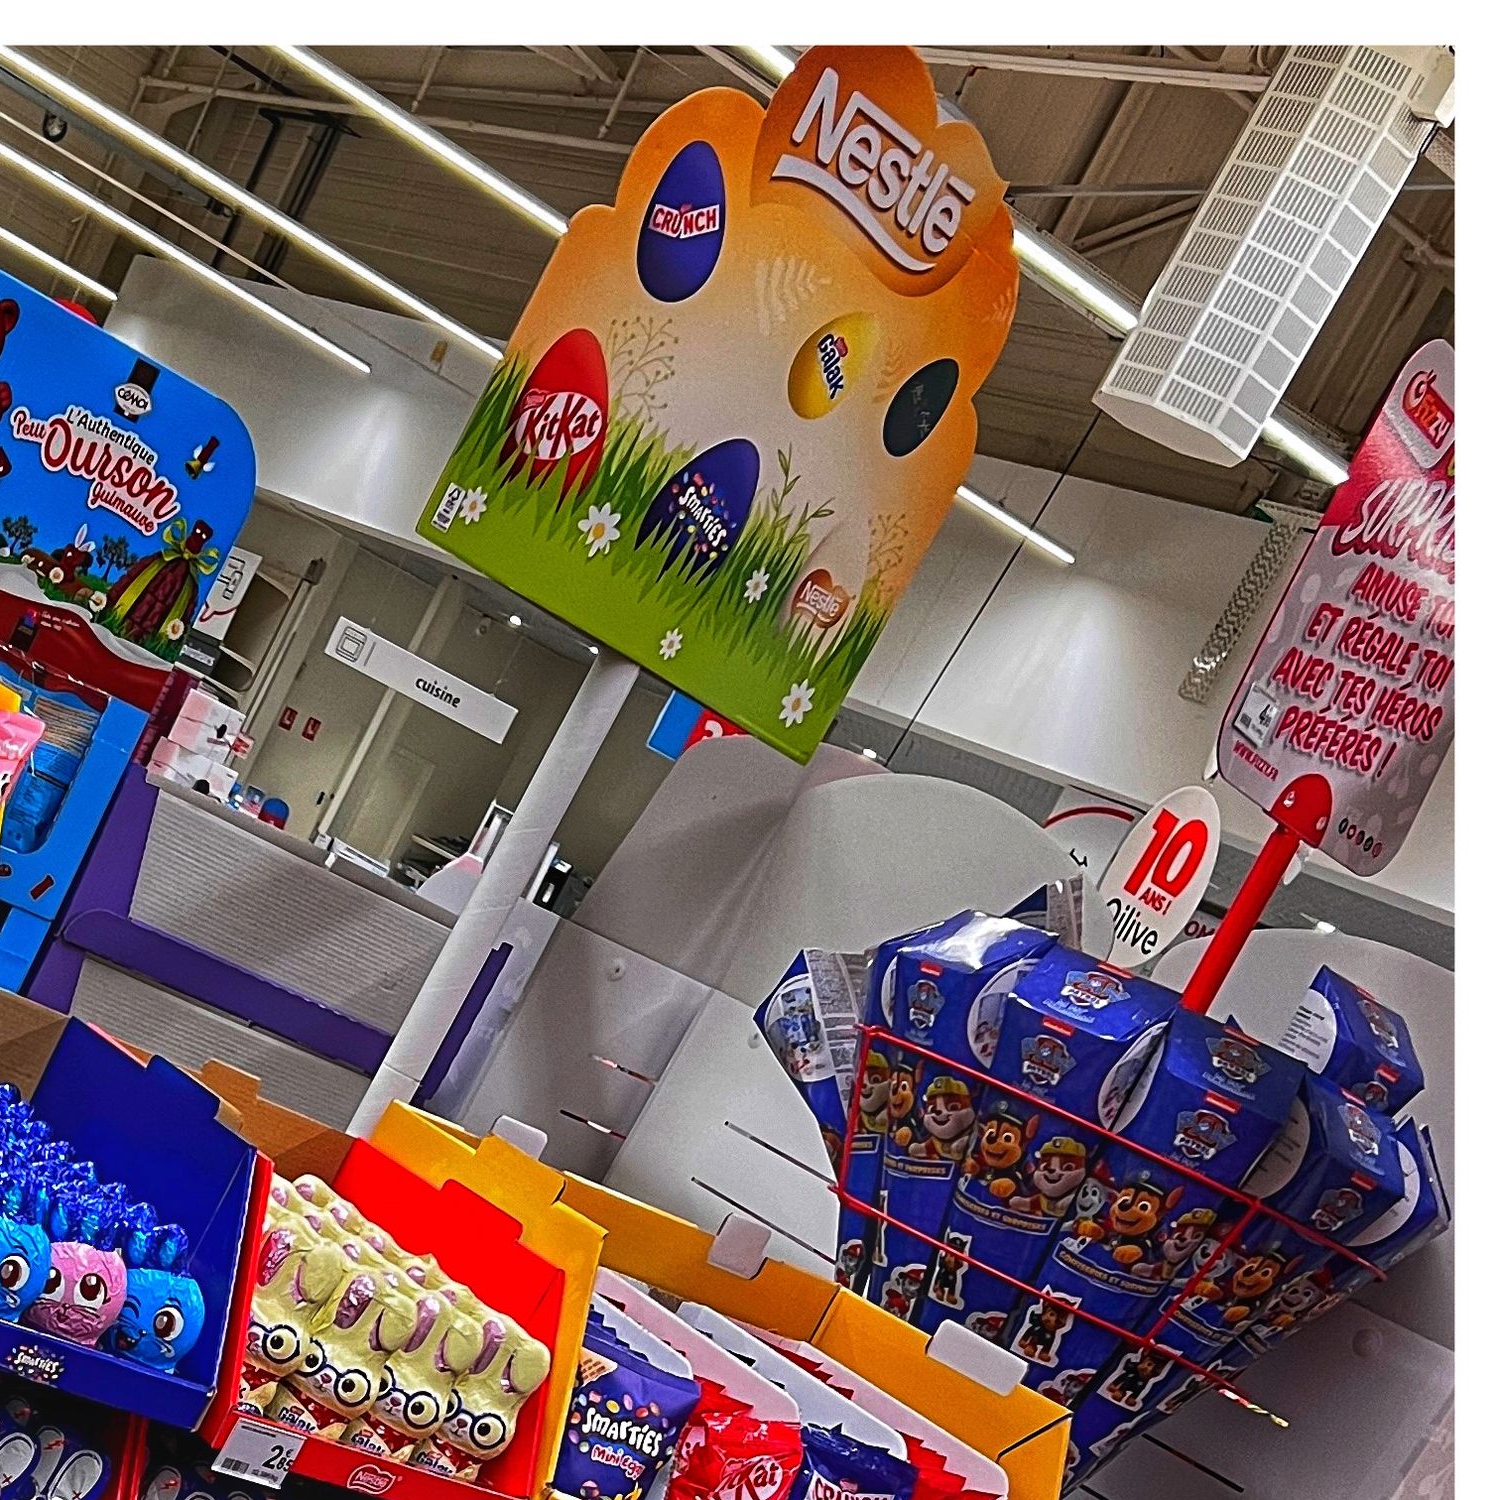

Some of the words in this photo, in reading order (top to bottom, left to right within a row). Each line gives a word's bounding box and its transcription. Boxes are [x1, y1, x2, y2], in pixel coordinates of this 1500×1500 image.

[650, 204, 720, 237] CRUNCH
[14, 411, 46, 439] Petit
[67, 409, 155, 465] L'Authentique
[524, 394, 600, 458] KitKat
[45, 418, 177, 519] Ourson
[1352, 562, 1429, 622] AMUSE
[1308, 602, 1344, 642] ET
[1338, 611, 1419, 675] RÉGALE
[1417, 650, 1455, 692] TOI
[415, 675, 461, 710] cuisine
[1272, 646, 1334, 698] AVEC
[1333, 670, 1376, 715] TES
[1371, 681, 1443, 741] HÉROS
[1275, 702, 1382, 772] PRÉFÉRÉS
[1124, 808, 1208, 898] 10
